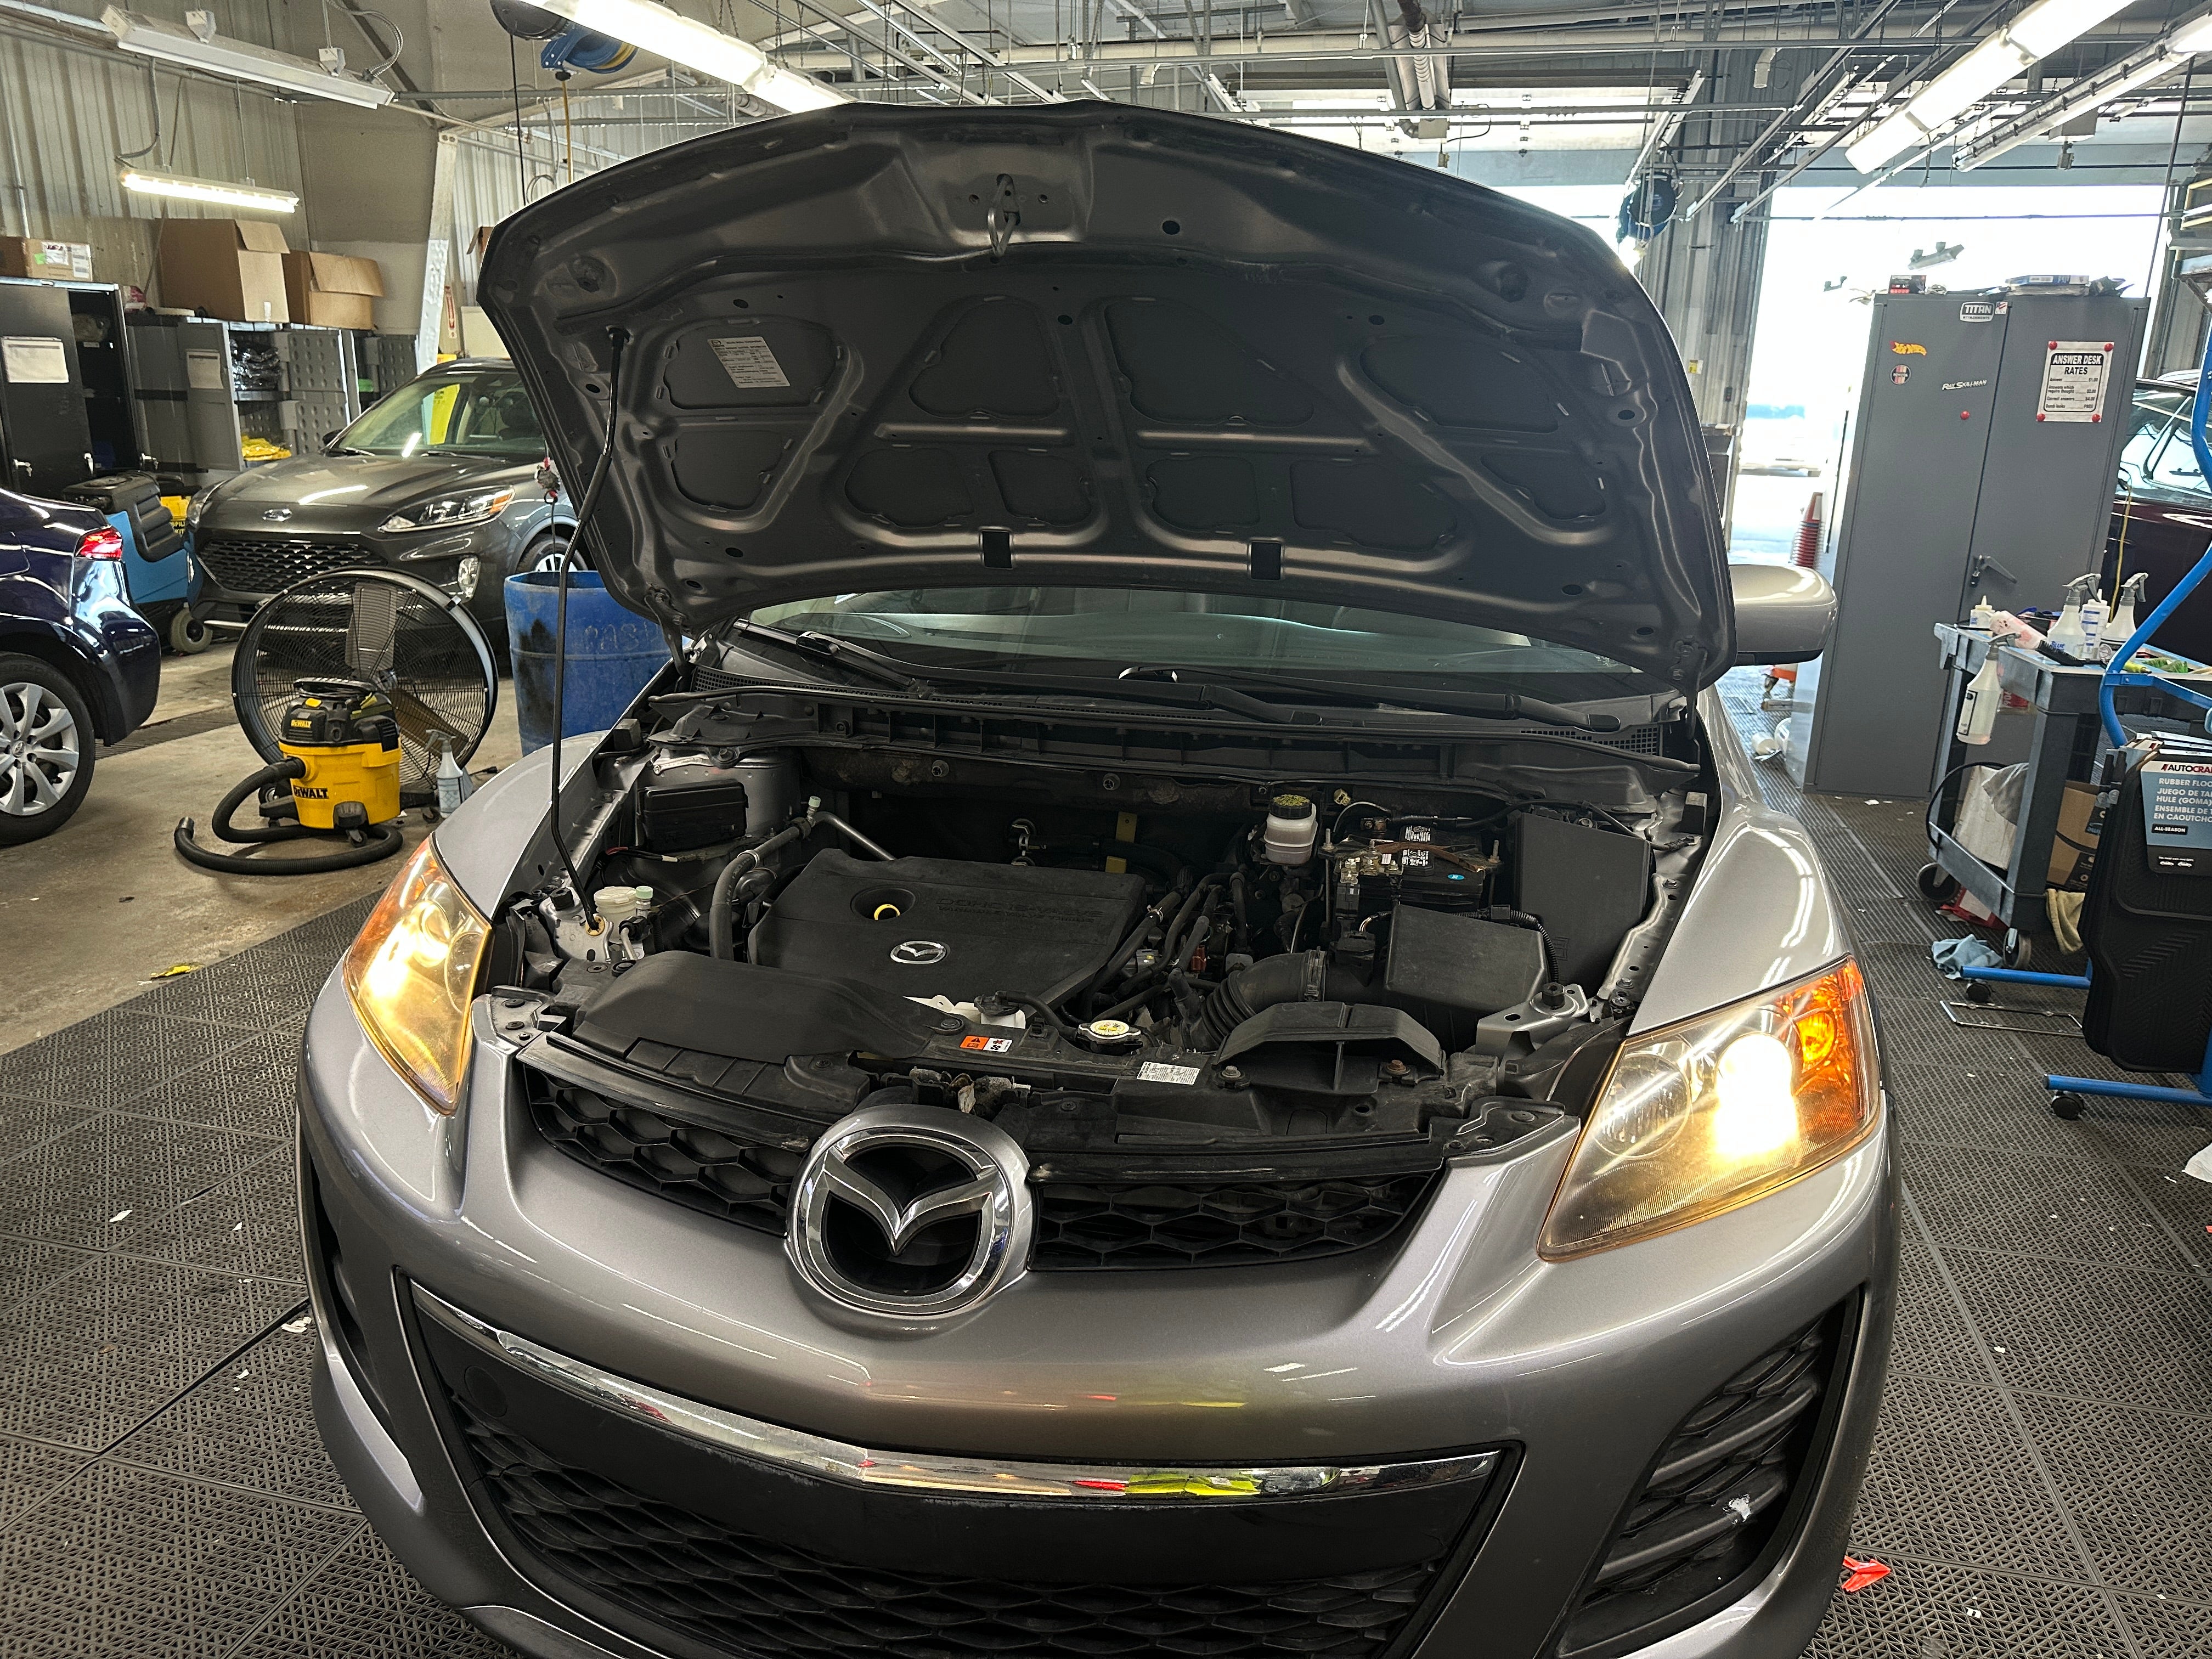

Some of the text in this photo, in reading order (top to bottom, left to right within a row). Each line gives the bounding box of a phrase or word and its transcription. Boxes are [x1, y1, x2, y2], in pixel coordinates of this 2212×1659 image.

[1965, 304, 1992, 314] TITAN
[2052, 355, 2102, 364] ANSWER DESK
[2168, 764, 2212, 774] AUTOCRA
[2159, 778, 2191, 786] RUBBER
[2179, 797, 2212, 806] (GOMA)
[2154, 805, 2196, 814] ENSEMBLE
